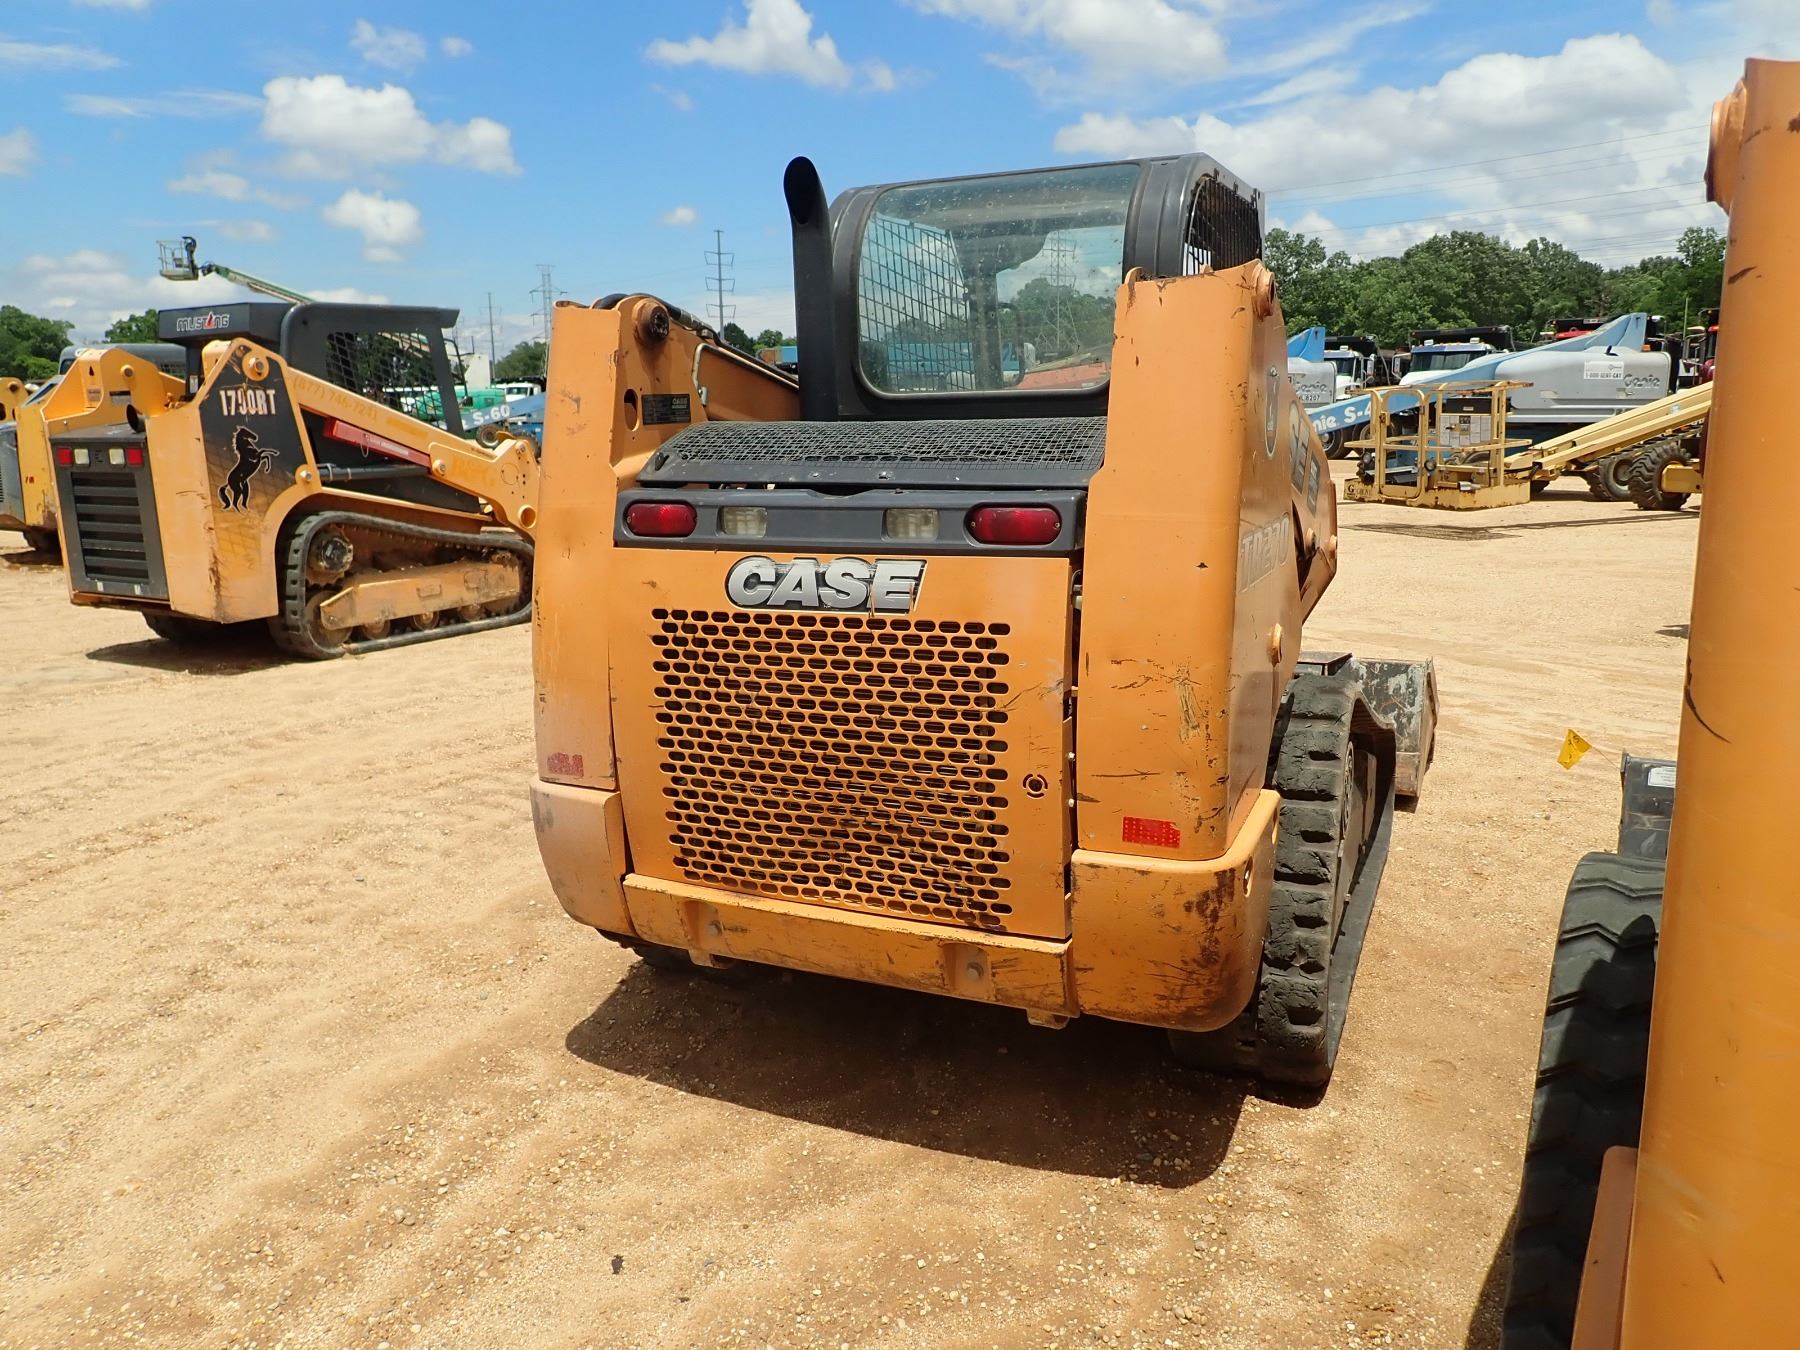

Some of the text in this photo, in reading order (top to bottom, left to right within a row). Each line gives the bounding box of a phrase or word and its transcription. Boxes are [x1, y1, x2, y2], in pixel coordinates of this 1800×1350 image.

[176, 312, 230, 331] MUSTANG
[1623, 373, 1660, 387] Genie
[472, 404, 511, 425] S-60
[1312, 401, 1371, 434] nie S-4
[725, 555, 927, 613] CASE
